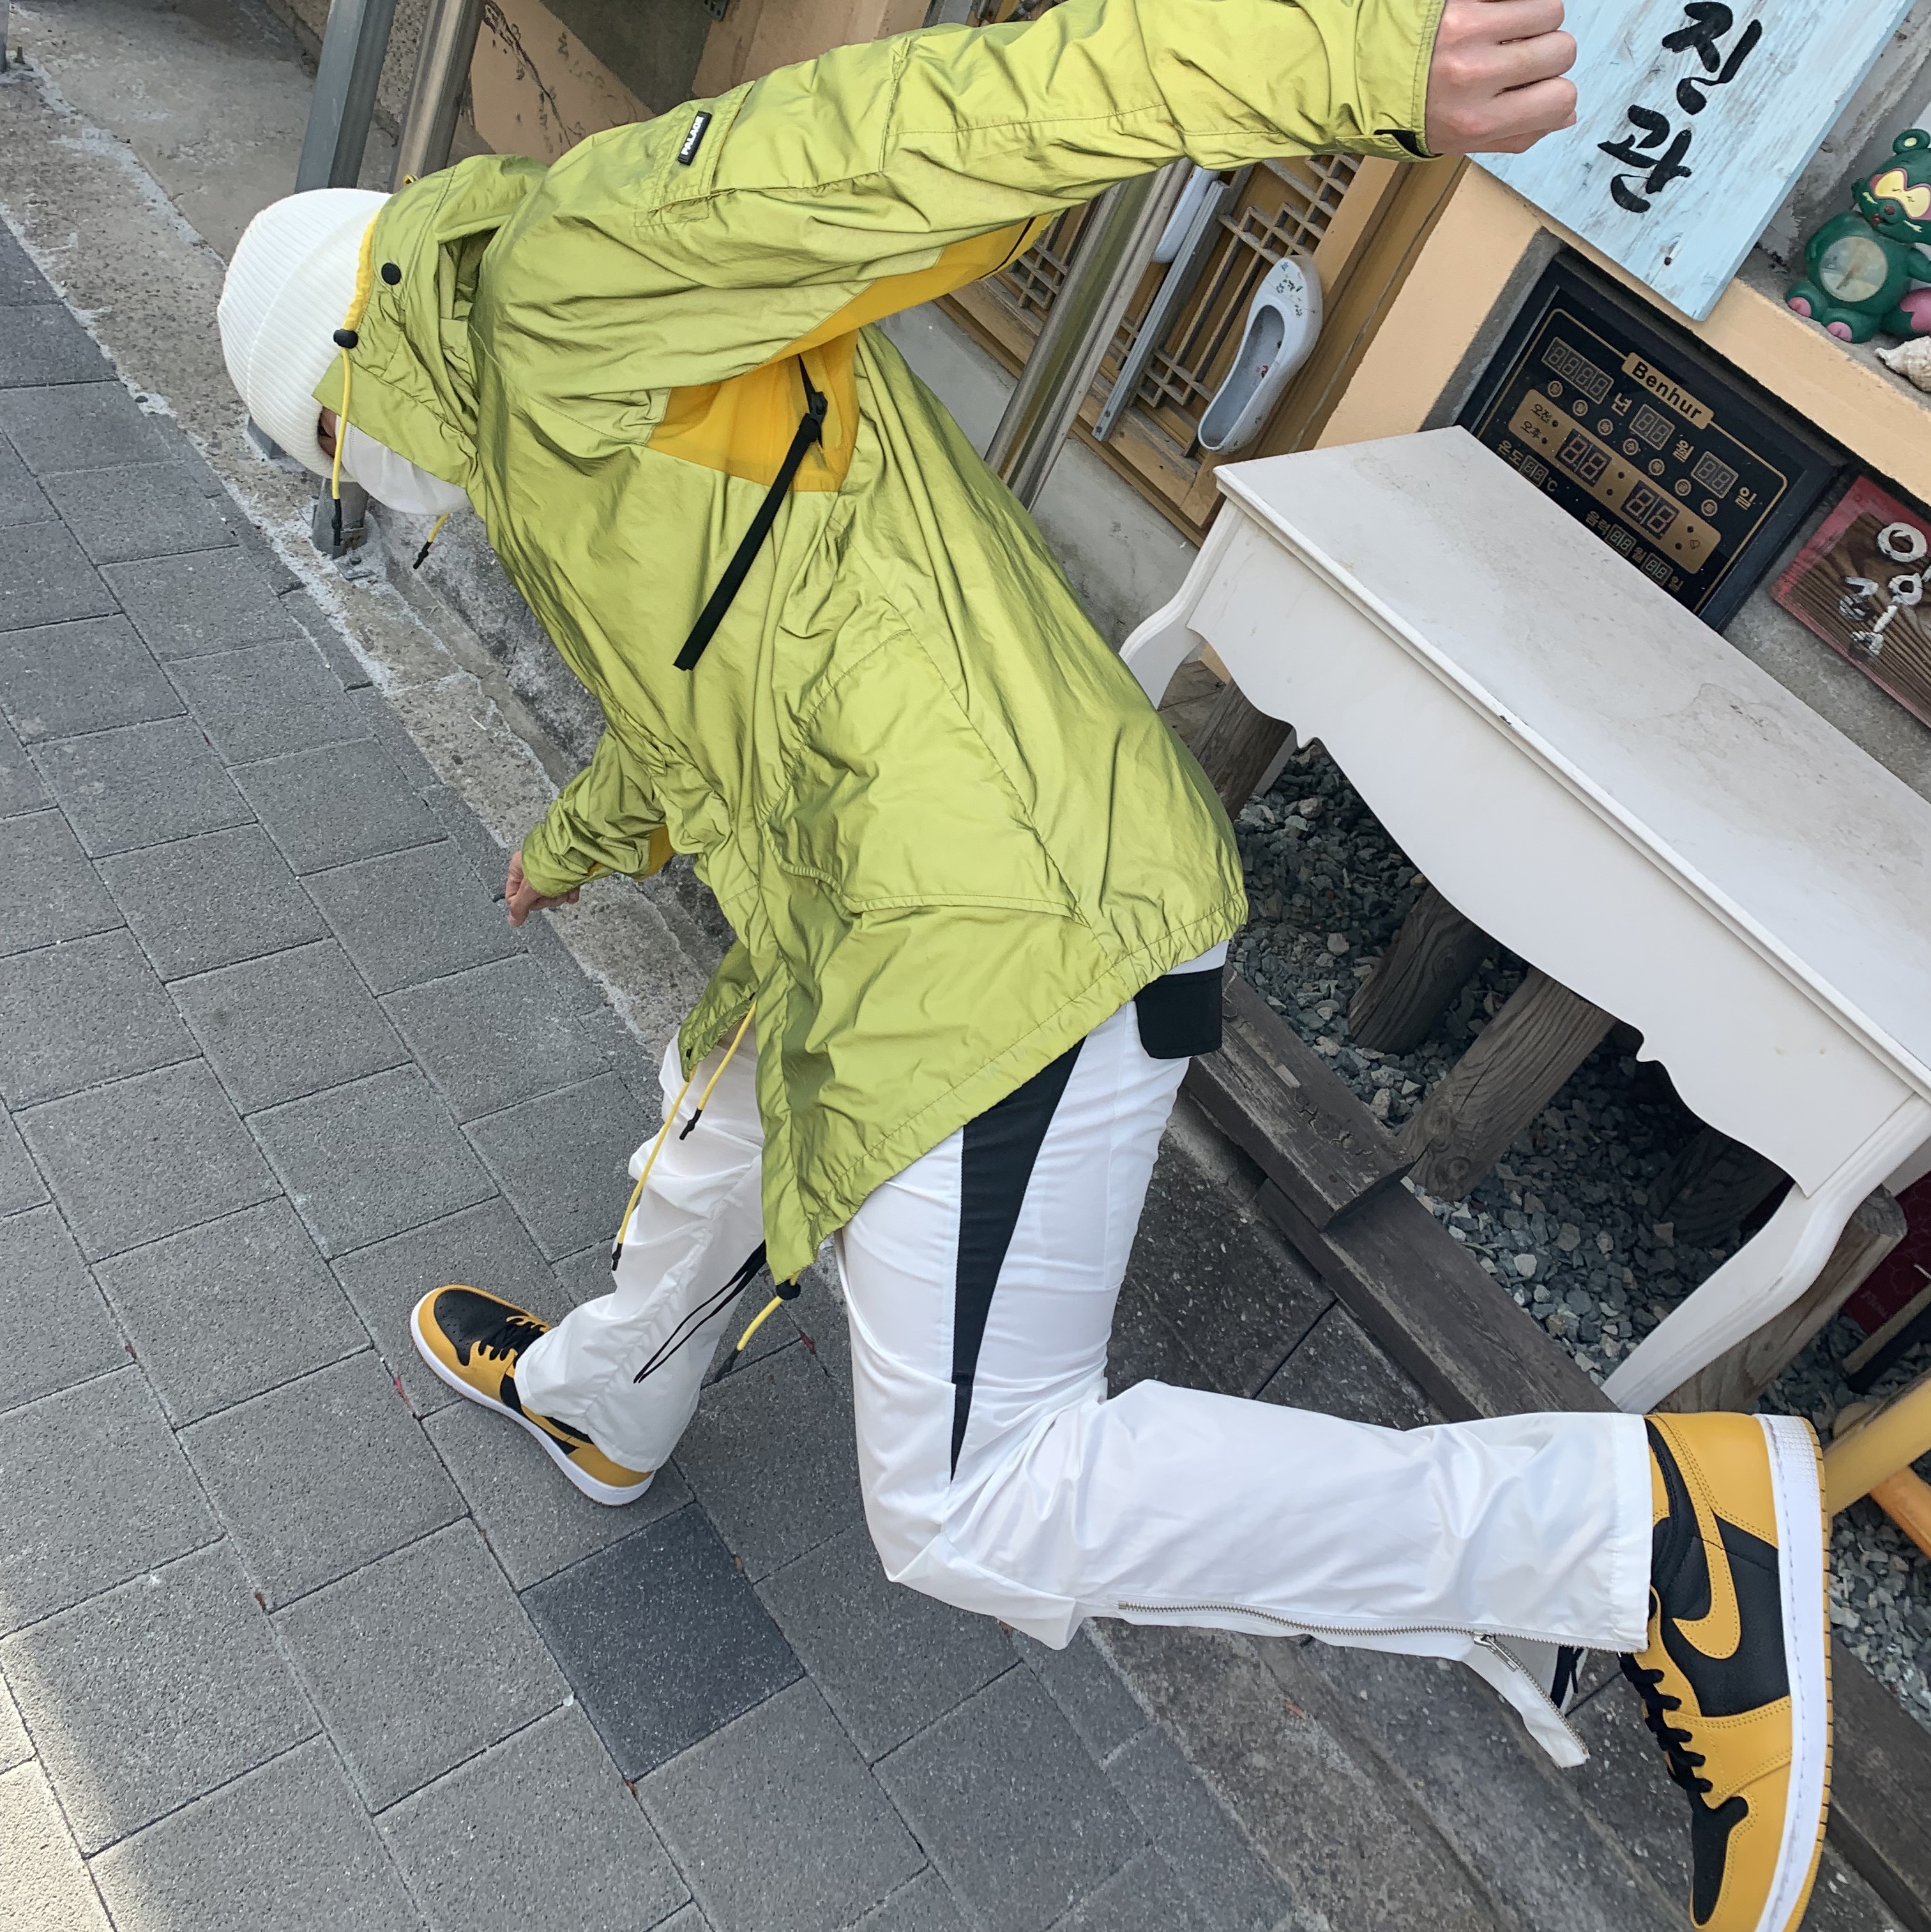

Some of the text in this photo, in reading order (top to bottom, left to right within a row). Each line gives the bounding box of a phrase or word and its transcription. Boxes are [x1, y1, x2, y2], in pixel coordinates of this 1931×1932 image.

[681, 116, 704, 155] PALACE
[1632, 361, 1702, 418] Benhur
[1520, 421, 1541, 439] 오후
[1531, 404, 1552, 423] 오전
[1497, 440, 1523, 466] 온도
[1611, 392, 1632, 416] 년
[1672, 440, 1694, 462] 월
[1734, 487, 1757, 510] 일
[1586, 511, 1610, 535] 음력
[1668, 576, 1684, 593] 일
